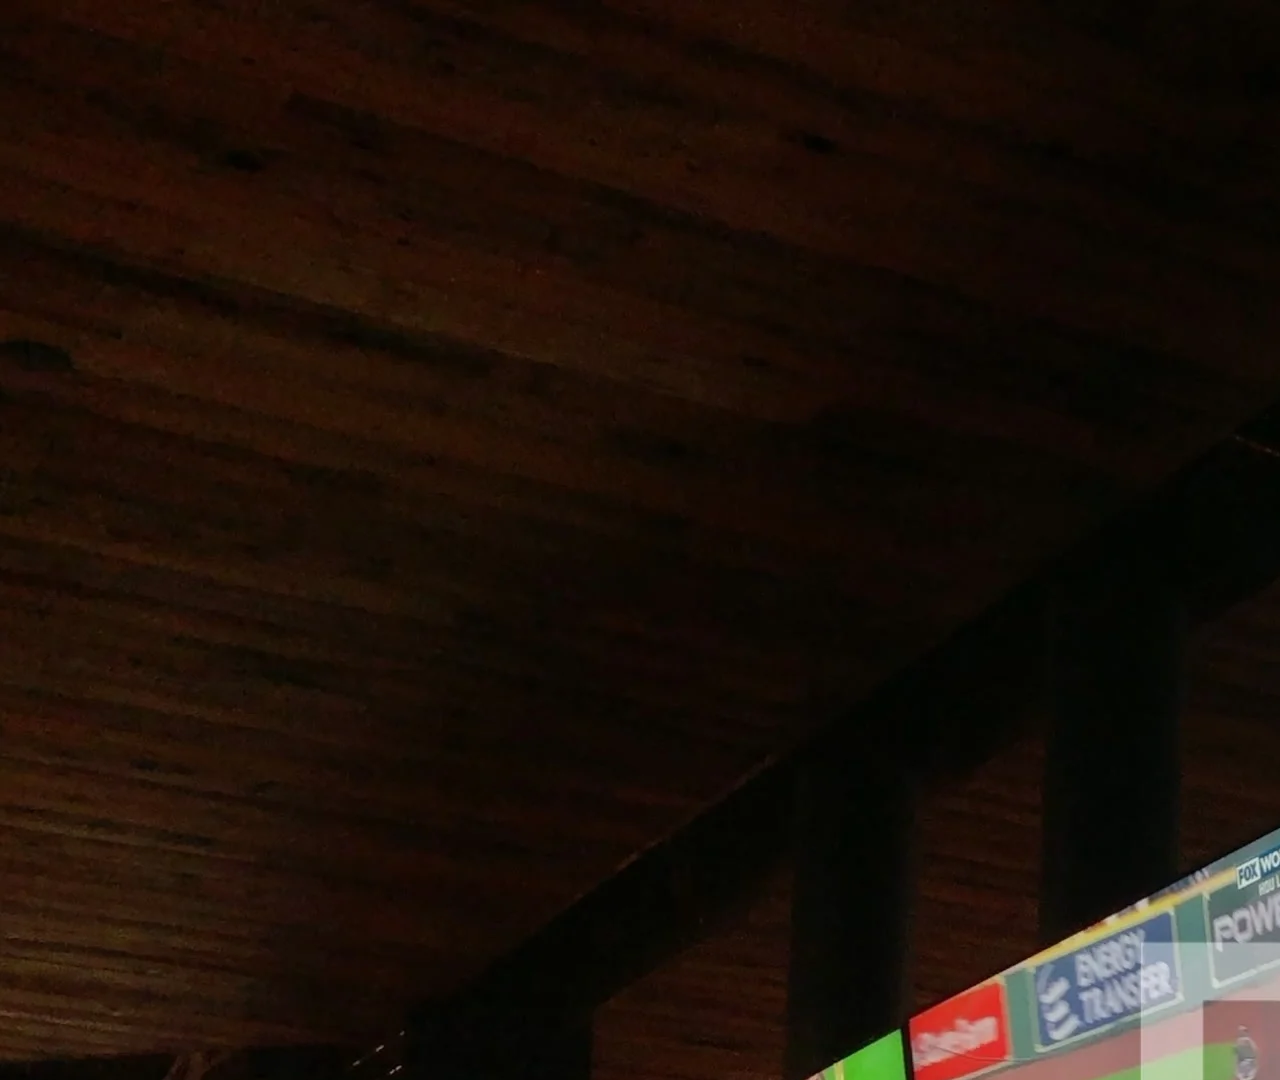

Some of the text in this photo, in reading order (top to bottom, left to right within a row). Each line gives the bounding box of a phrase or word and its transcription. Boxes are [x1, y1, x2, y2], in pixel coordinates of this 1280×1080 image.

[1238, 860, 1260, 886] FOX
[1075, 929, 1146, 987] ENERGY
[1079, 960, 1176, 1025] TRANSFER
